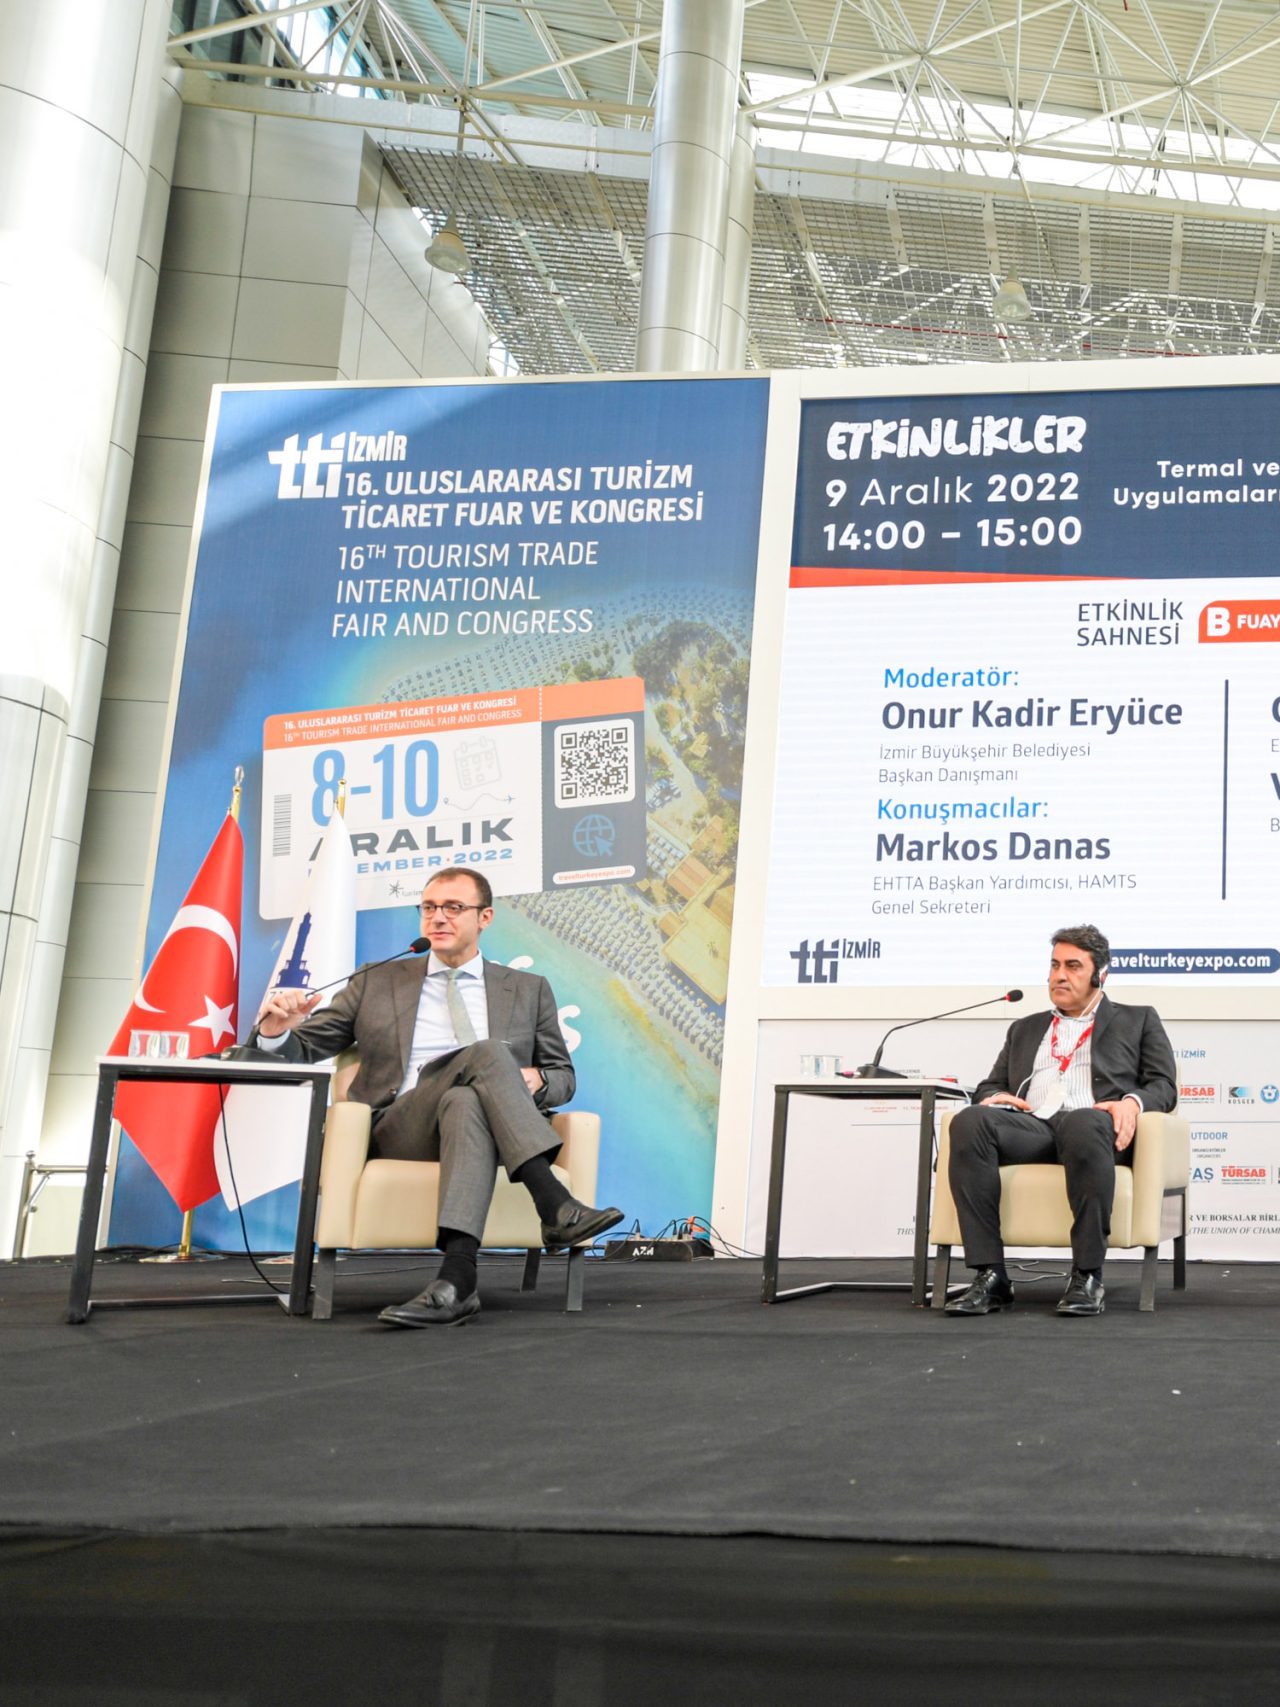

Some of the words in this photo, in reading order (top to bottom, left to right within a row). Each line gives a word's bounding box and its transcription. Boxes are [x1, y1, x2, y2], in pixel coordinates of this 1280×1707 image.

[348, 430, 408, 462] İZMİR
[827, 415, 1087, 461] ETKİNLİKLER
[345, 472, 378, 496] 16.
[385, 467, 581, 495] ULUSLARARASI
[590, 459, 692, 490] TURİZM
[1157, 457, 1243, 478] Termal
[1252, 461, 1280, 476] ve
[826, 479, 847, 507] 9
[860, 476, 973, 506] Aralık
[987, 472, 1079, 502] 2022
[342, 499, 445, 529] TİCARET
[454, 501, 522, 527] FUAR
[531, 500, 562, 525] VE
[570, 491, 704, 524] KONGRESİ
[823, 520, 925, 551] 14:00
[976, 516, 1082, 547] 15:00
[339, 544, 386, 570] 16TH
[394, 542, 509, 568] TOURISM
[519, 541, 599, 566] TRADE
[336, 576, 540, 604] INTERNATIONAL
[332, 613, 387, 637] FAIR
[395, 611, 449, 637] AND
[457, 609, 593, 635] CONGRESS
[1078, 598, 1183, 622] ETKİNLİK
[1207, 607, 1231, 636] B
[1077, 623, 1180, 646] SAHNESİ
[884, 667, 1019, 688] Moderatör:
[284, 720, 296, 730] 16.
[298, 714, 362, 729] ULUSLARARASI
[364, 710, 397, 721] TURİZM
[399, 705, 434, 718] TİCARET
[436, 703, 458, 714] FUAR
[460, 702, 472, 711] VE
[473, 695, 517, 709] KONGRESİ
[302, 728, 340, 741] TOURISM
[342, 725, 368, 736] TRADE
[370, 718, 435, 733] INTERNATIONAL
[438, 716, 456, 726] FAIR
[457, 713, 476, 724] AND
[477, 709, 523, 722] CONGRESS
[882, 701, 963, 729] Onur
[972, 698, 1060, 728] Kadir
[1070, 698, 1183, 735] Eryüce
[879, 743, 917, 760] İzmir
[922, 743, 1008, 762] Büyükşehir
[1012, 742, 1091, 762] Belediyesi
[878, 768, 933, 786] Başkan
[938, 767, 1018, 786] Danışmanı
[877, 796, 1049, 825] Konuşmacılar:
[876, 832, 998, 862] Markos
[1008, 831, 1111, 861] Danas
[873, 876, 924, 891] EHTTA
[929, 876, 984, 893] Başkan
[989, 875, 1073, 892] Yardımcısı,
[1078, 874, 1138, 890] HAMTS
[871, 900, 914, 915] Genel
[920, 899, 991, 915] Sekreteri
[842, 938, 881, 959] İZMİR
[1110, 952, 1271, 972] avelturkeyexpo.com
[1191, 1131, 1228, 1141] UTDOOR
[1221, 1166, 1266, 1178] TÜRSAB
[1196, 1214, 1208, 1222] VE
[1209, 1214, 1257, 1222] BORSALAR
[1210, 1226, 1238, 1235] UNION
[1239, 1226, 1250, 1235] OF
